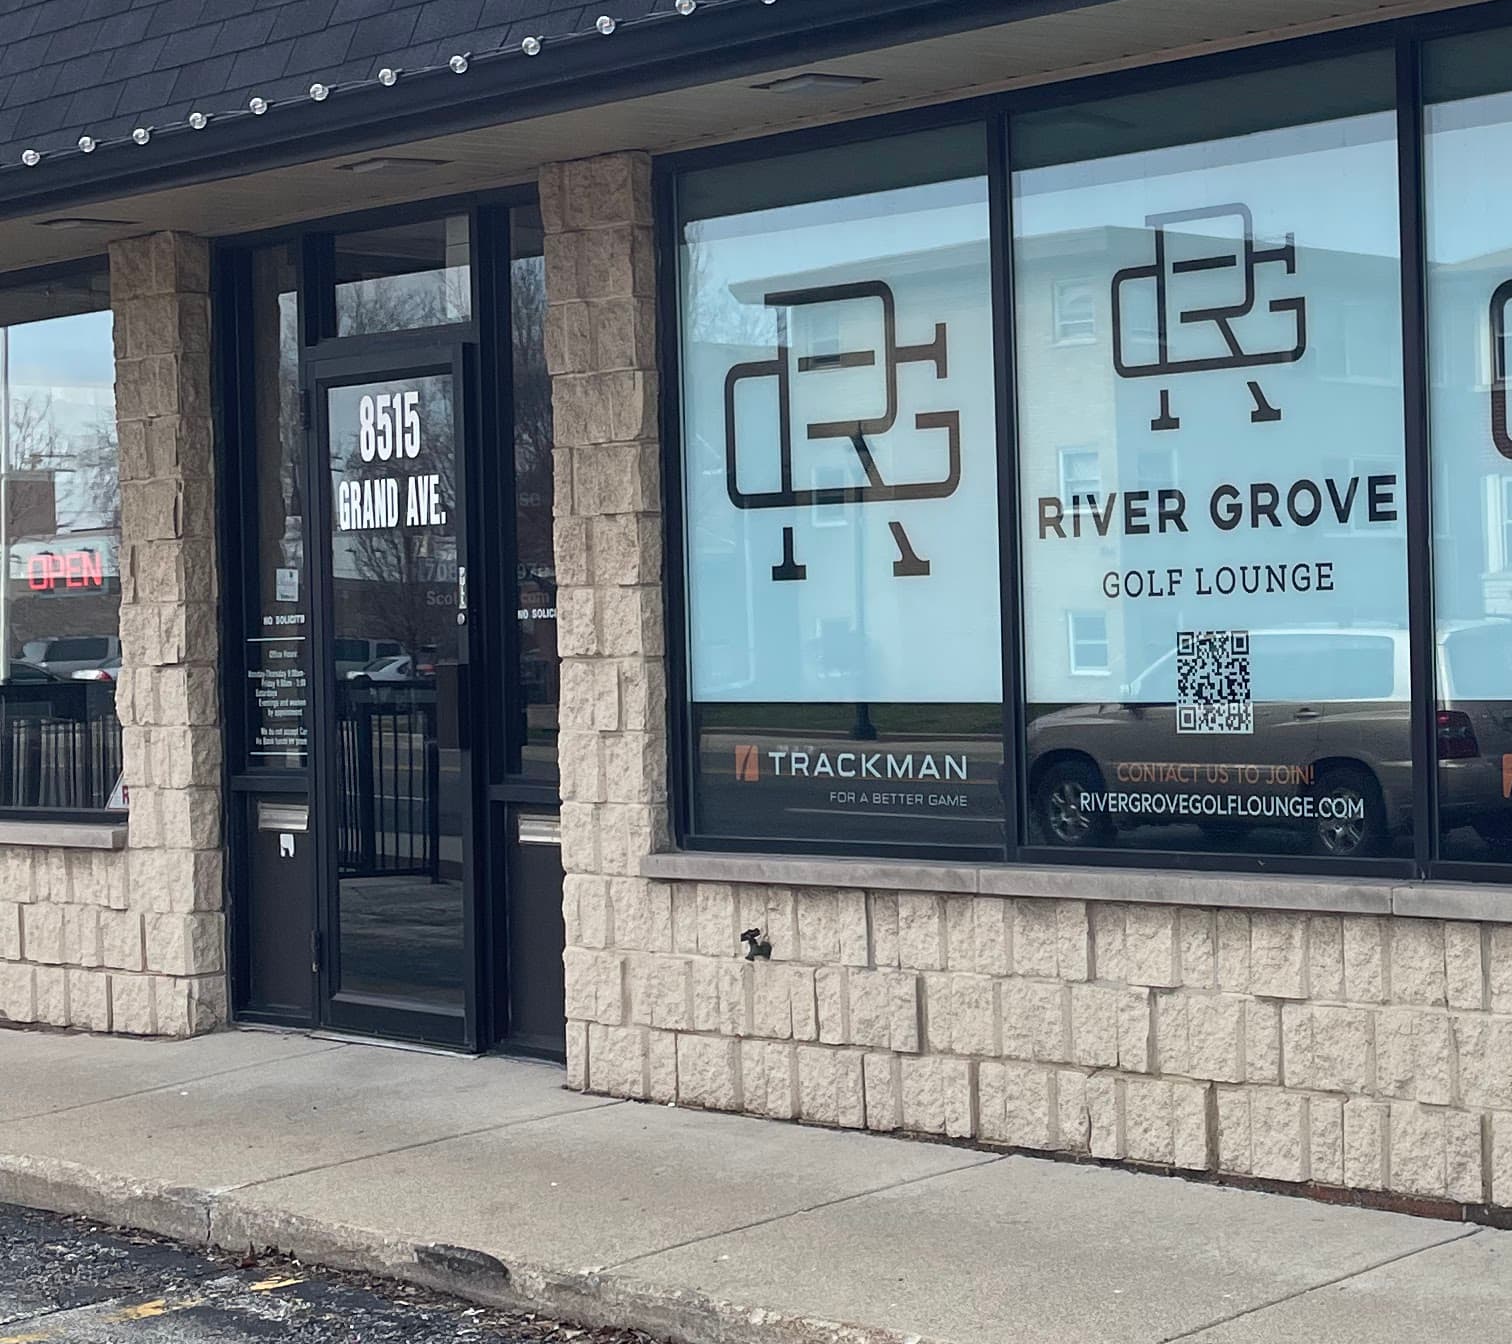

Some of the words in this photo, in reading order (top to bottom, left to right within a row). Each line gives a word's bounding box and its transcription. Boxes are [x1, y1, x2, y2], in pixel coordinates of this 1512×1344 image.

[359, 391, 421, 462] 8515
[338, 478, 399, 531] GRAND
[406, 474, 447, 527] AVE.
[1038, 489, 1189, 540] RIVER
[1209, 474, 1399, 532] GROVE
[28, 551, 104, 590] OPEN
[1102, 567, 1183, 599] GOLF
[1195, 562, 1335, 596] LOUNGE
[517, 609, 529, 620] NO
[768, 752, 968, 781] TRACKMAN
[1117, 762, 1199, 784] CONTACT
[1207, 764, 1229, 785] US
[1235, 765, 1260, 785] TO
[1266, 765, 1316, 785] JOIN!
[830, 791, 856, 804] FOR
[860, 792, 869, 804] A
[872, 792, 924, 806] BETTER
[928, 794, 968, 807] GAME
[1080, 791, 1365, 820] RIVERGROVEGOLFLOUNGE.COM
